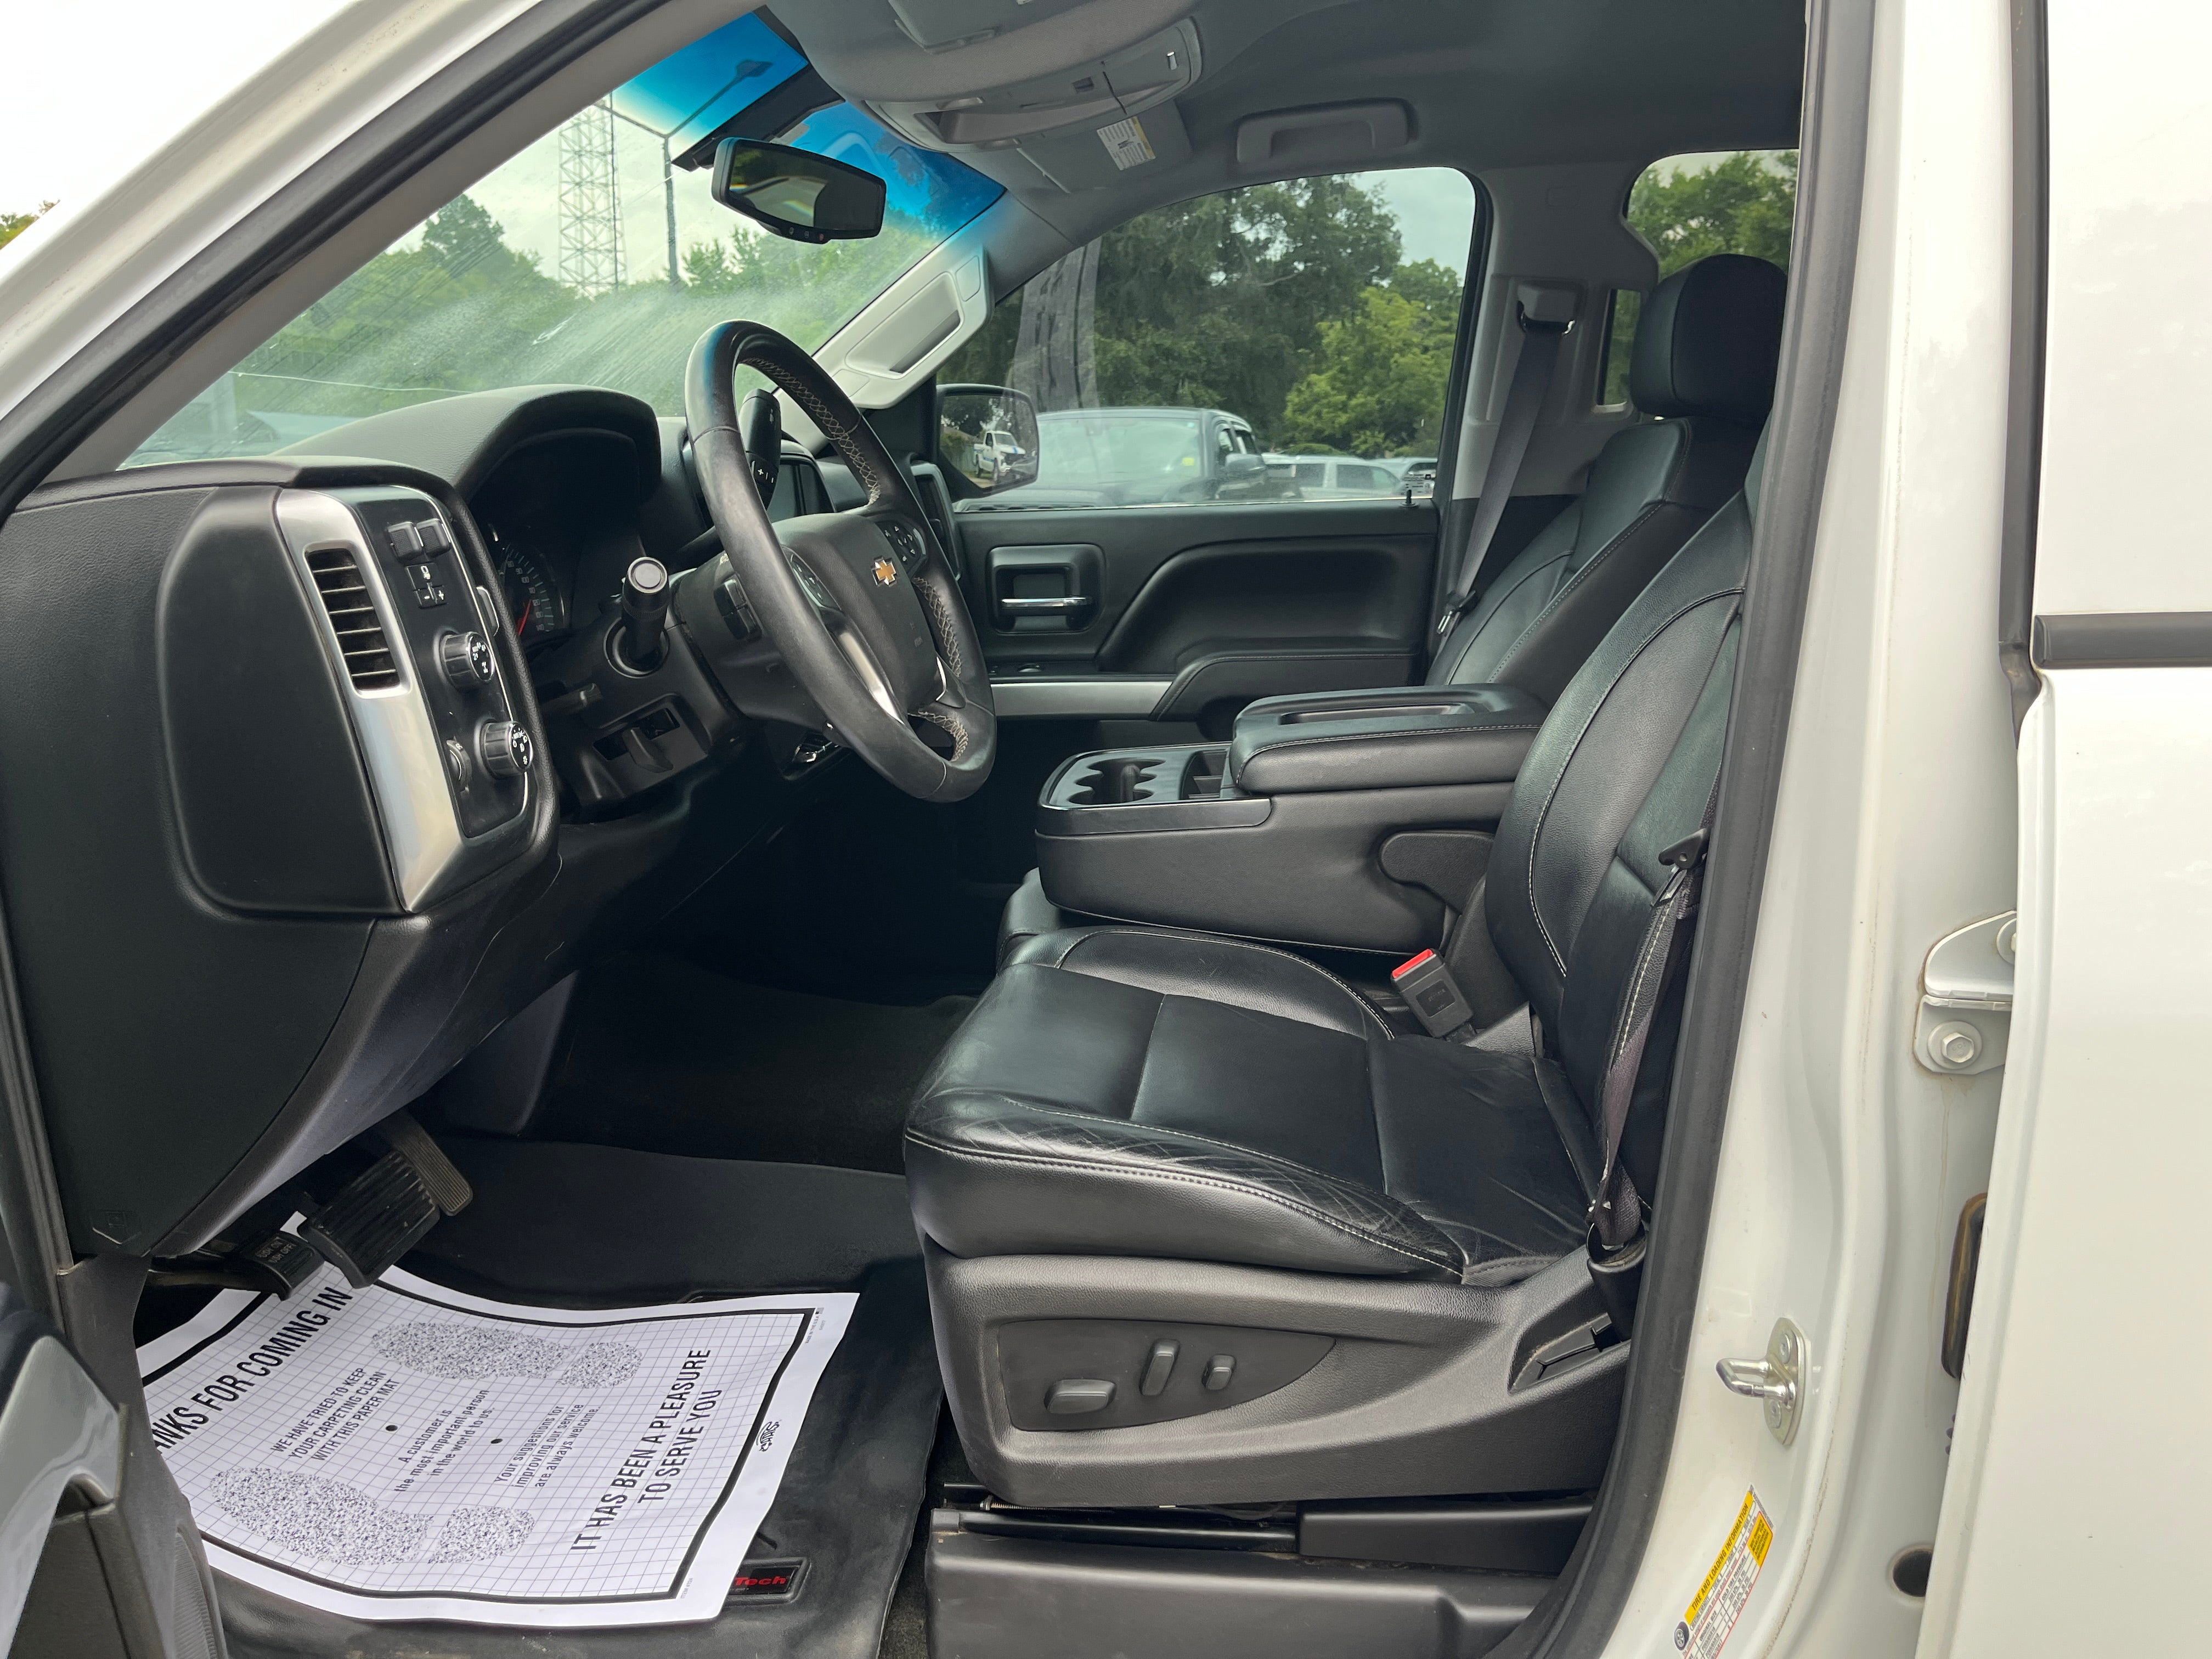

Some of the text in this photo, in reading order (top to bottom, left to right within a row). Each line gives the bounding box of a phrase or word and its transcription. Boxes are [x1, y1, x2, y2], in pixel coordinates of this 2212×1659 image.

[190, 1375, 255, 1411] FOR
[236, 1310, 331, 1376] COMING
[312, 1286, 353, 1311] IN
[270, 1368, 366, 1453] WE HAVE TRIED TO KEEP
[288, 1371, 387, 1459] YOUR CARPETING CLEAN
[311, 1379, 400, 1461] WITH THIS PAPER MAT
[393, 1390, 490, 1492] the most important person
[407, 1418, 444, 1455] customer
[436, 1453, 456, 1466] the
[451, 1430, 476, 1452] world
[479, 1407, 495, 1419] us.
[494, 1406, 565, 1482] Your suggestions for
[511, 1404, 584, 1488] improving our service
[534, 1406, 601, 1487] are always welcome.
[570, 1350, 712, 1550] IT HAS BEEN A PLEASURE
[637, 1389, 723, 1504] TO SERVE YOU
[1691, 1502, 1748, 1612] TIRE AND LOADING INFORMATION
